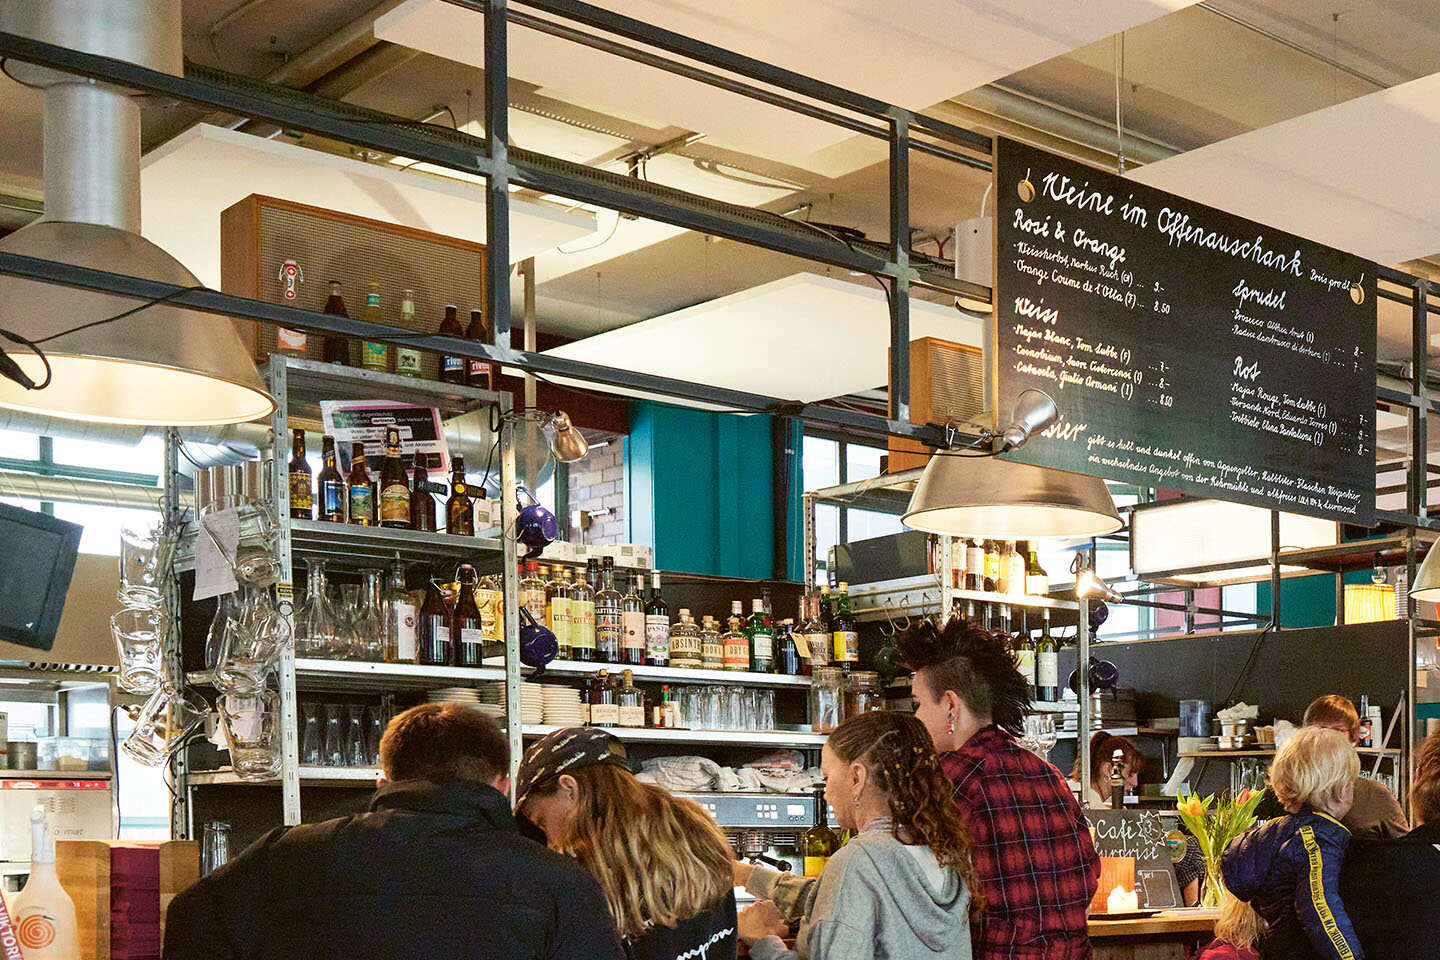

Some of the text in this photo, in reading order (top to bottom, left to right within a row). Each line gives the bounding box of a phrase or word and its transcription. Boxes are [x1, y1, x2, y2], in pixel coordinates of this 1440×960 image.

[1043, 172, 1113, 215] Weine
[1120, 194, 1148, 228] im
[1013, 208, 1126, 270] Rosé & Orange
[1016, 259, 1049, 286] Orange
[1082, 279, 1093, 293] de
[1014, 295, 1060, 325] Weiss
[1232, 279, 1287, 310] Sprudel
[1233, 356, 1261, 381] Rot
[1136, 444, 1151, 455] und
[1195, 474, 1208, 484] der
[1096, 816, 1138, 852] Café
